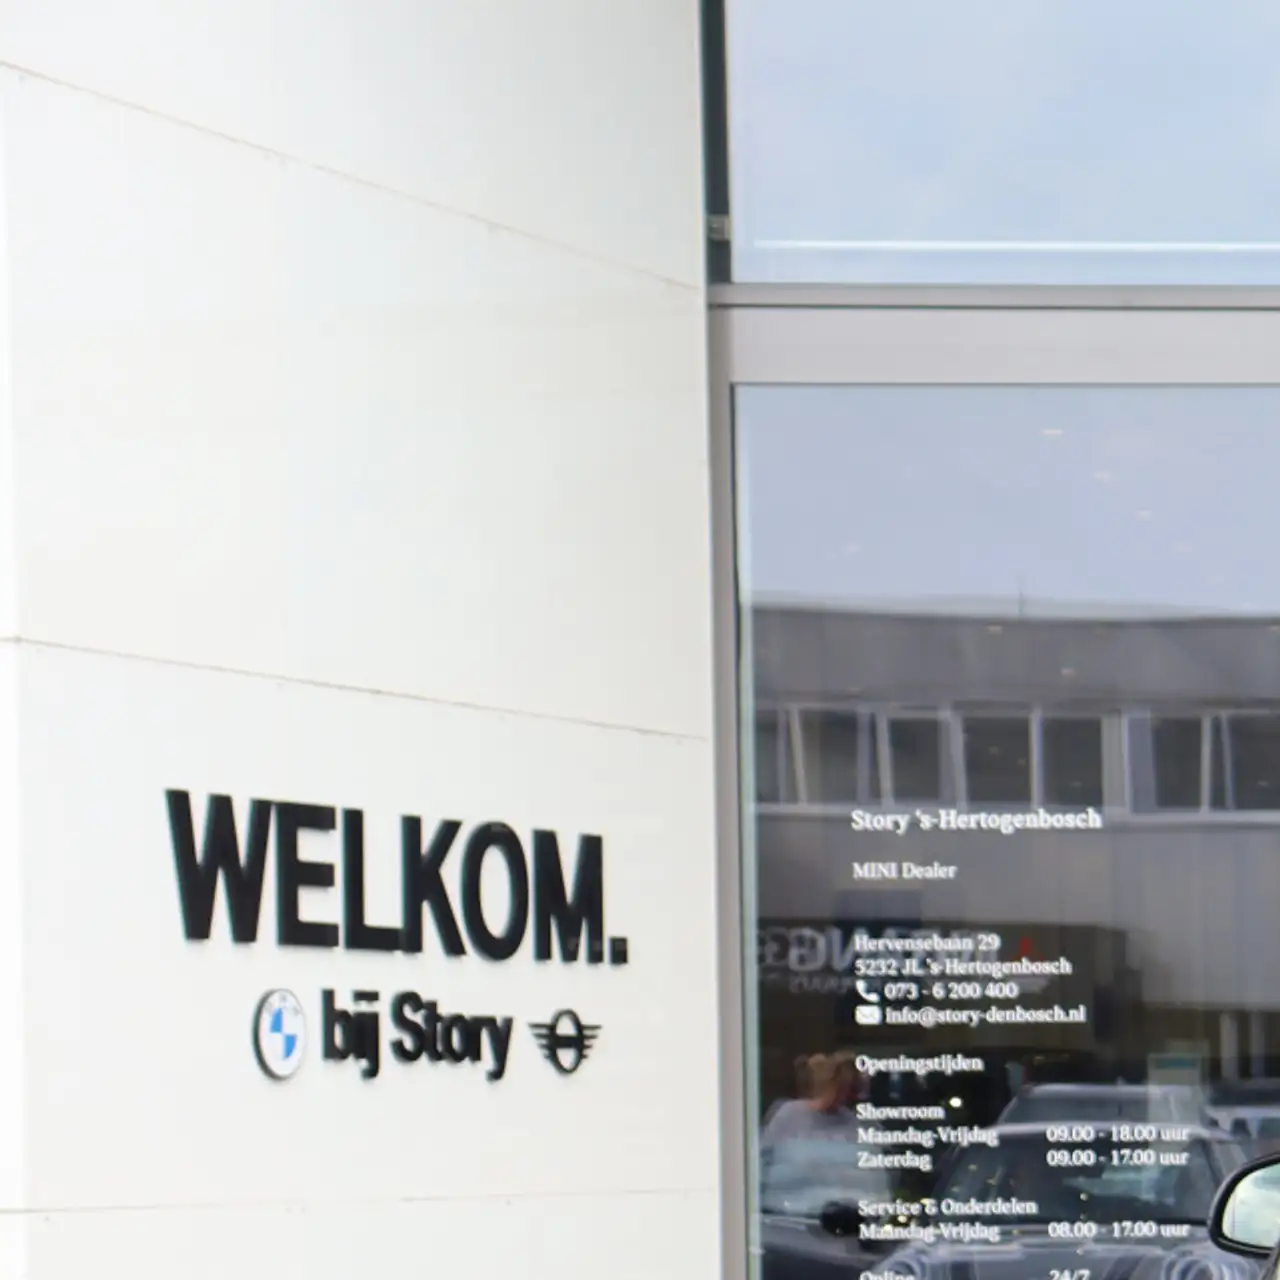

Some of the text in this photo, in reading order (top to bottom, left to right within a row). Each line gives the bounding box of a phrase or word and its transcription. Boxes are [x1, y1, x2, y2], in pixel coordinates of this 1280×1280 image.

[851, 809, 911, 835] Story
[165, 787, 629, 966] WELKOM.
[852, 861, 958, 880] MINI Dealer
[854, 933, 1001, 952] Hervensebaan 29
[854, 958, 897, 976] 5232
[901, 958, 924, 976] JL
[883, 981, 919, 1000] 073
[931, 982, 945, 1000] 6
[947, 981, 982, 999] 200
[984, 981, 1019, 999] 400
[884, 1003, 1087, 1027] info@story-denbosch.nl
[320, 988, 514, 1081] bij Story
[855, 1054, 984, 1076] Openingstijden
[855, 1102, 945, 1120] Showroom
[857, 1125, 999, 1148] Maandag-Vrijdag
[1046, 1125, 1094, 1142] 09.00
[1110, 1125, 1155, 1141] 18.00
[1160, 1127, 1191, 1141] uur
[857, 1150, 933, 1172] Zaterdag
[1046, 1149, 1096, 1166] 09.00
[1110, 1149, 1156, 1166] 17.00
[1160, 1152, 1191, 1166] uur
[858, 1199, 922, 1216] Service
[940, 1197, 1039, 1215] Onderdelen
[859, 1222, 1001, 1242] Maandag-Vrijdag
[1047, 1221, 1098, 1238] 08.00
[1111, 1221, 1156, 1238] 17.00
[1160, 1224, 1192, 1238] uur
